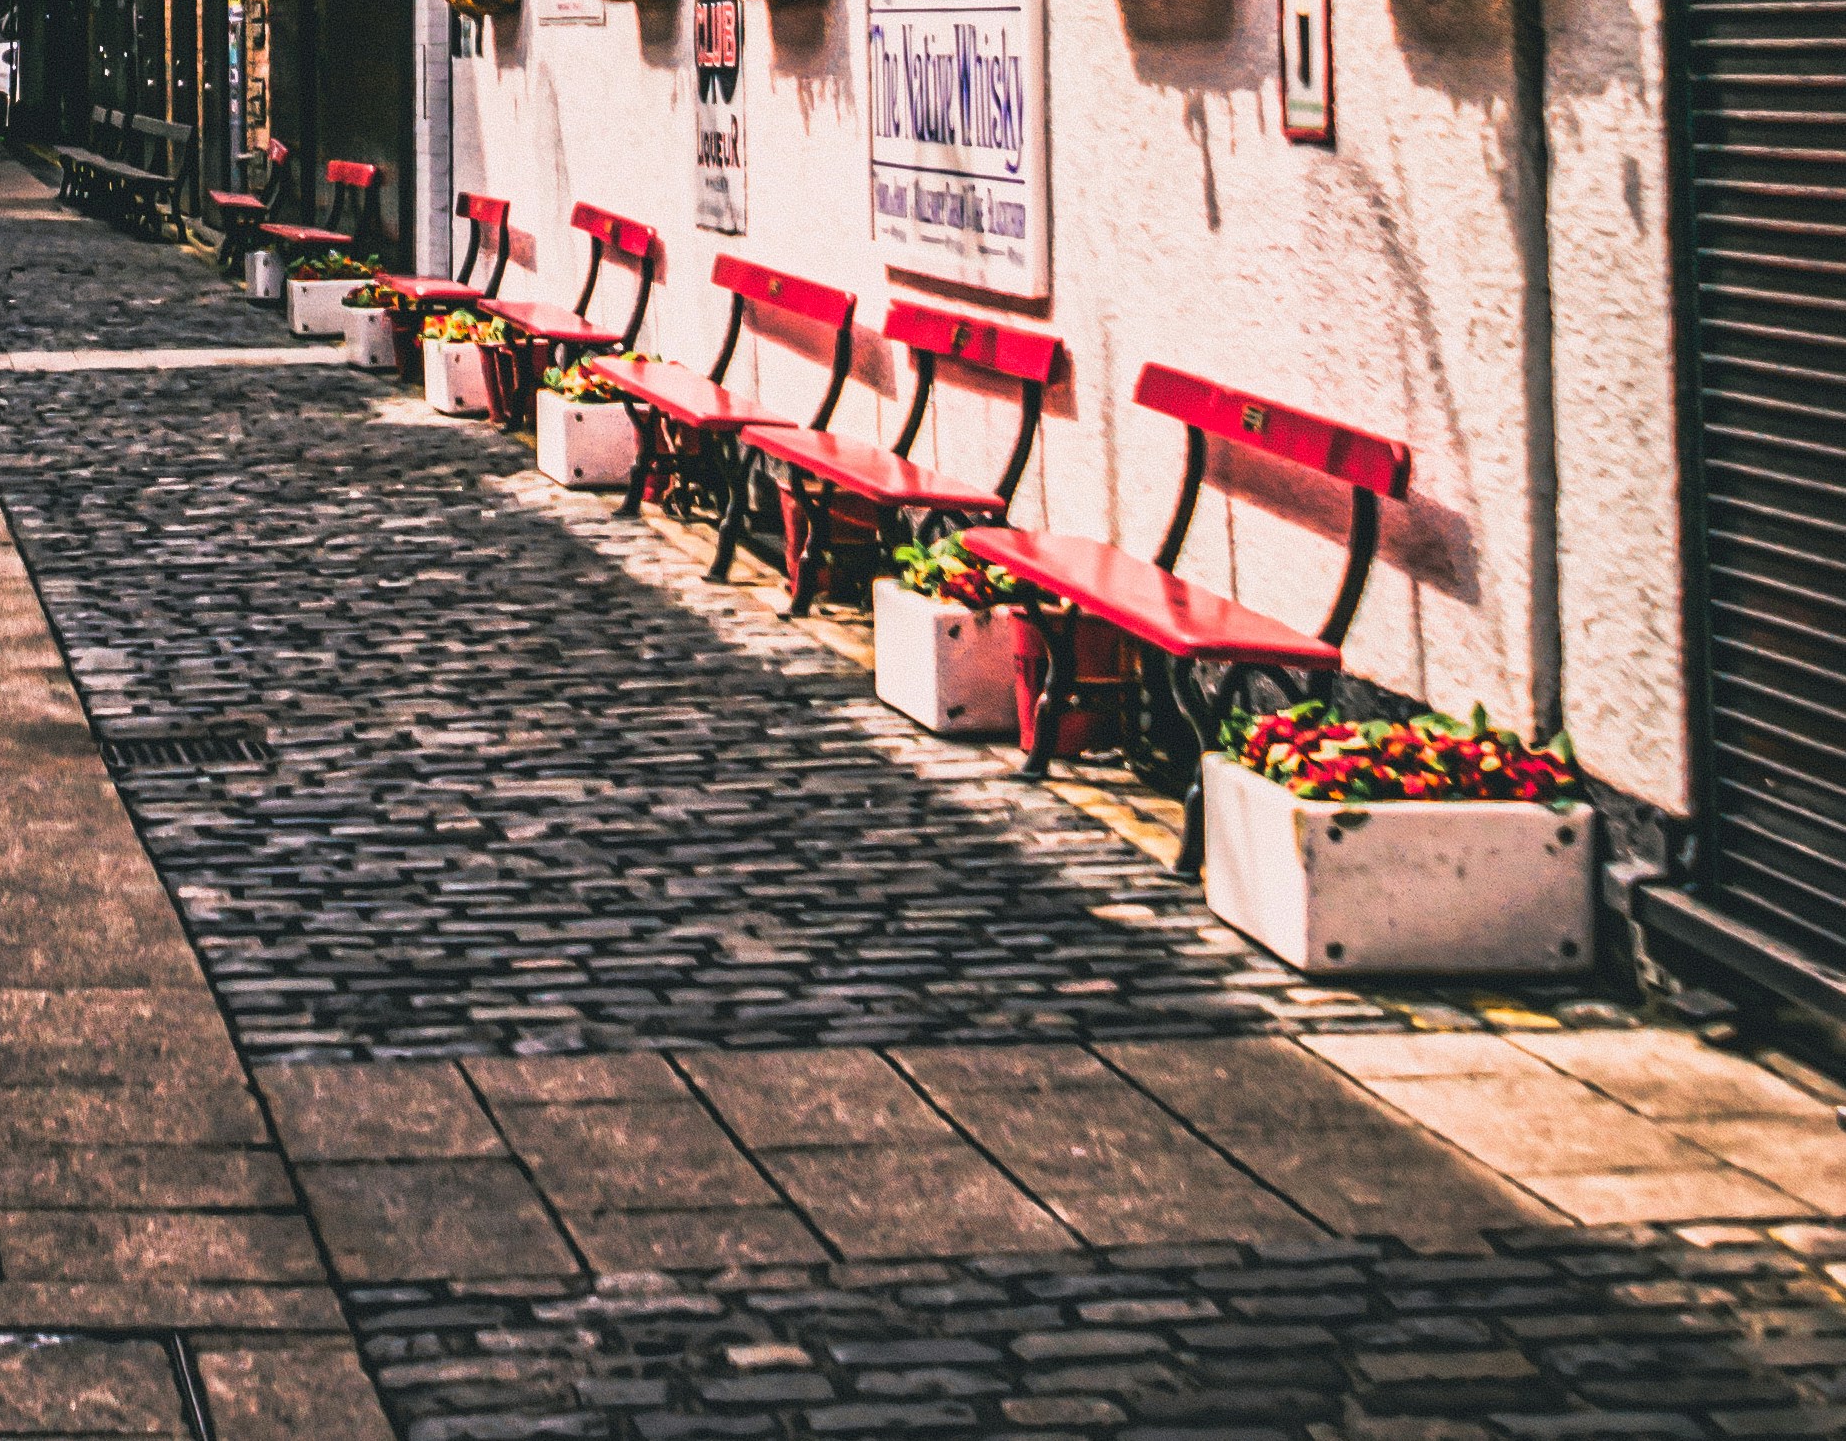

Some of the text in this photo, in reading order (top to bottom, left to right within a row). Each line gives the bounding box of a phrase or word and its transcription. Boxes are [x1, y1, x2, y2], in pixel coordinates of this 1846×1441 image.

[696, 0, 737, 68] CLUB
[870, 23, 1025, 175] The Native Whisky
[697, 114, 741, 169] LIQUEUR
